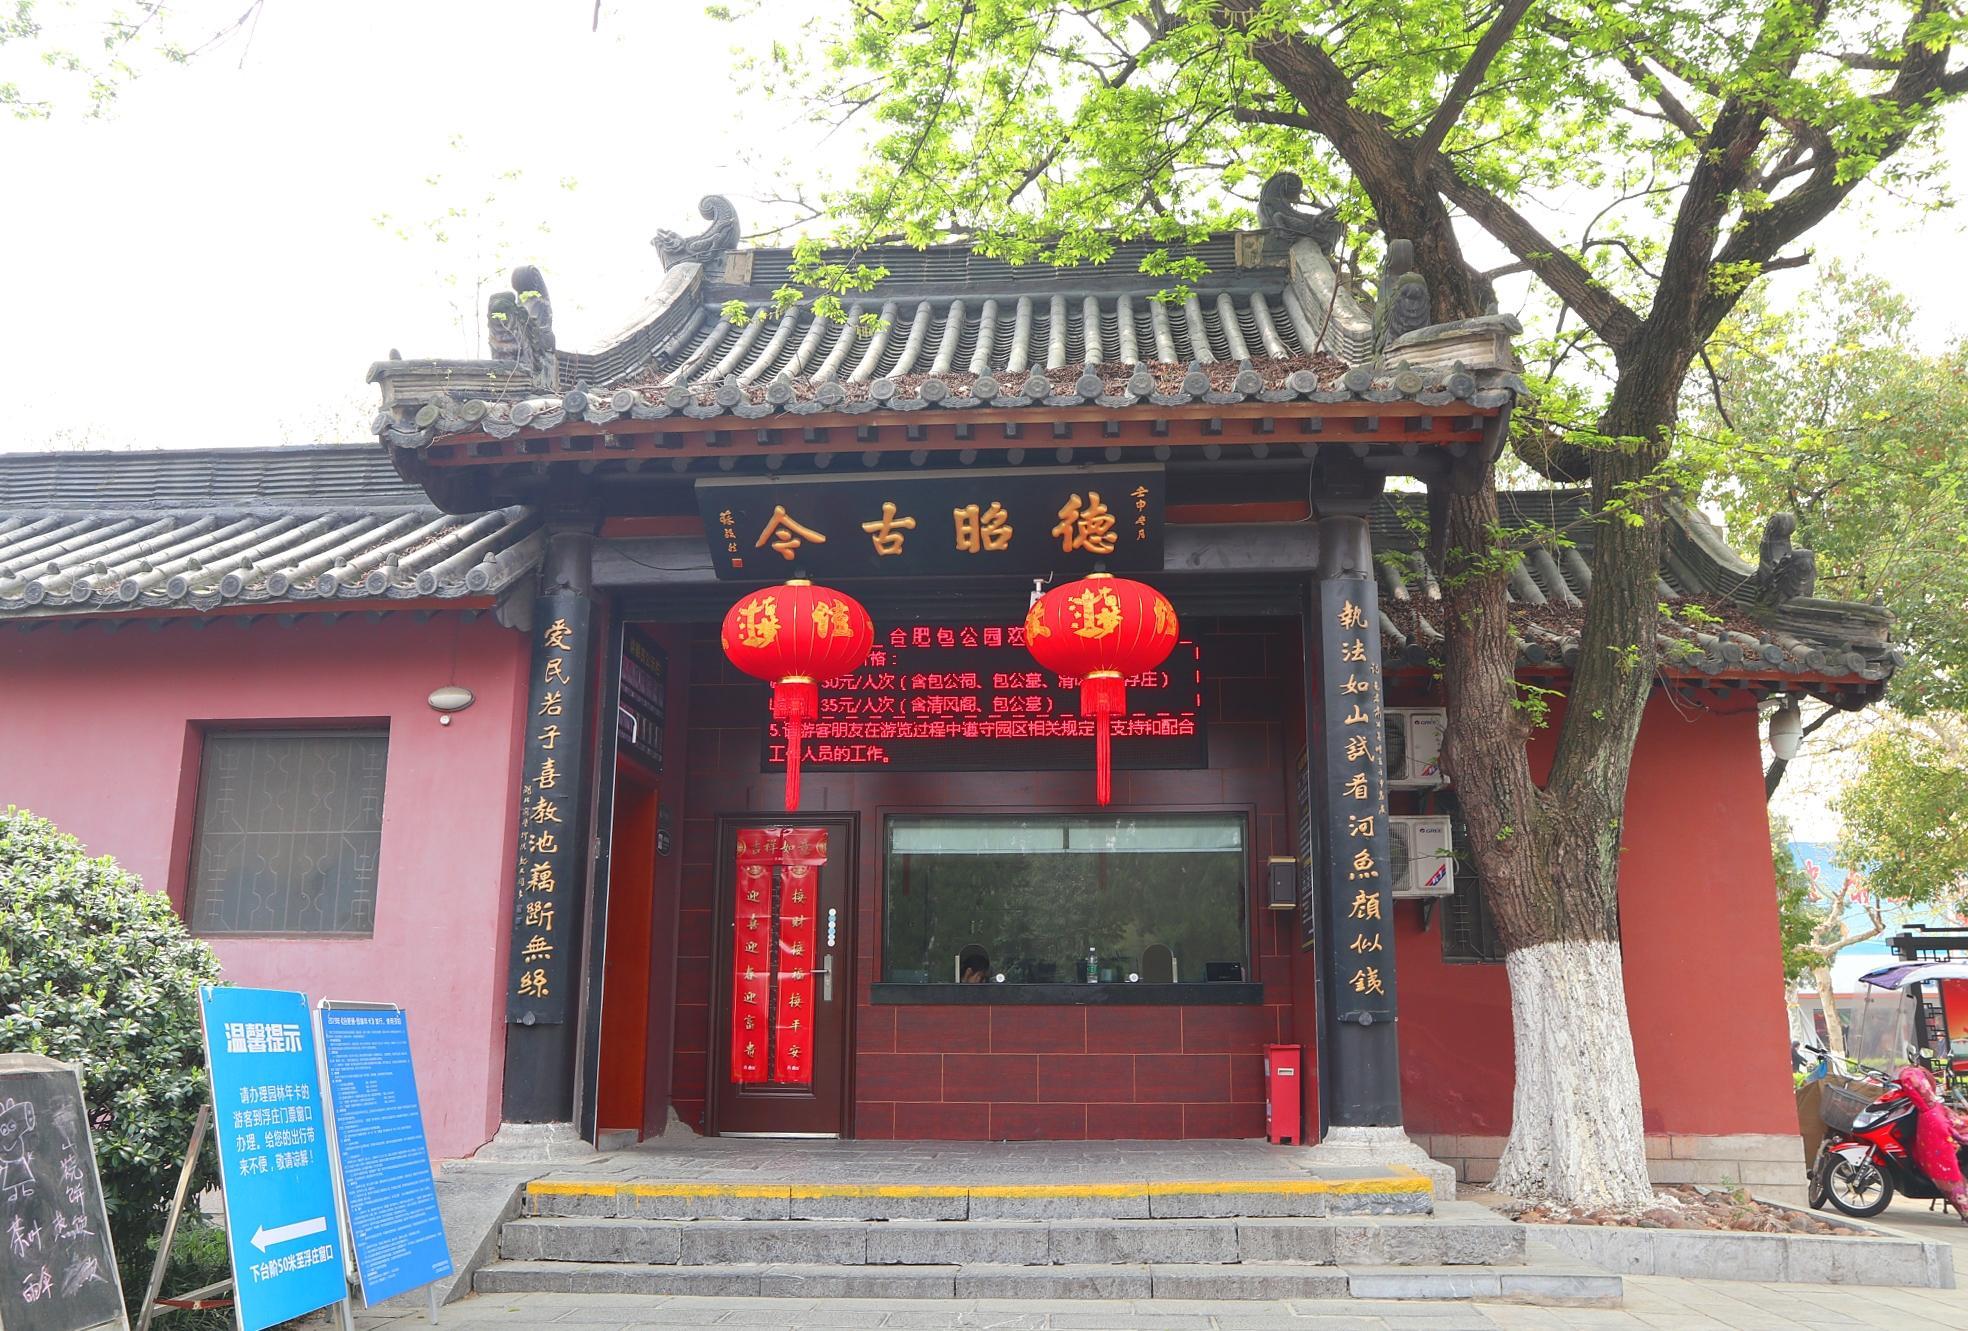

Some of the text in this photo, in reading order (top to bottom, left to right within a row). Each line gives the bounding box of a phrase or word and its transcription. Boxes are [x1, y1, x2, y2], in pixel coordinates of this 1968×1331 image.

[769, 744, 889, 763] 工人员的工作。
[224, 1022, 302, 1053] 温馨提示
[240, 1083, 310, 1104] 请办理园林年卡的
[233, 1105, 313, 1128] 游客到浮庄门票窗口
[249, 1244, 335, 1283] 下台阶50米至浮庄窗口
